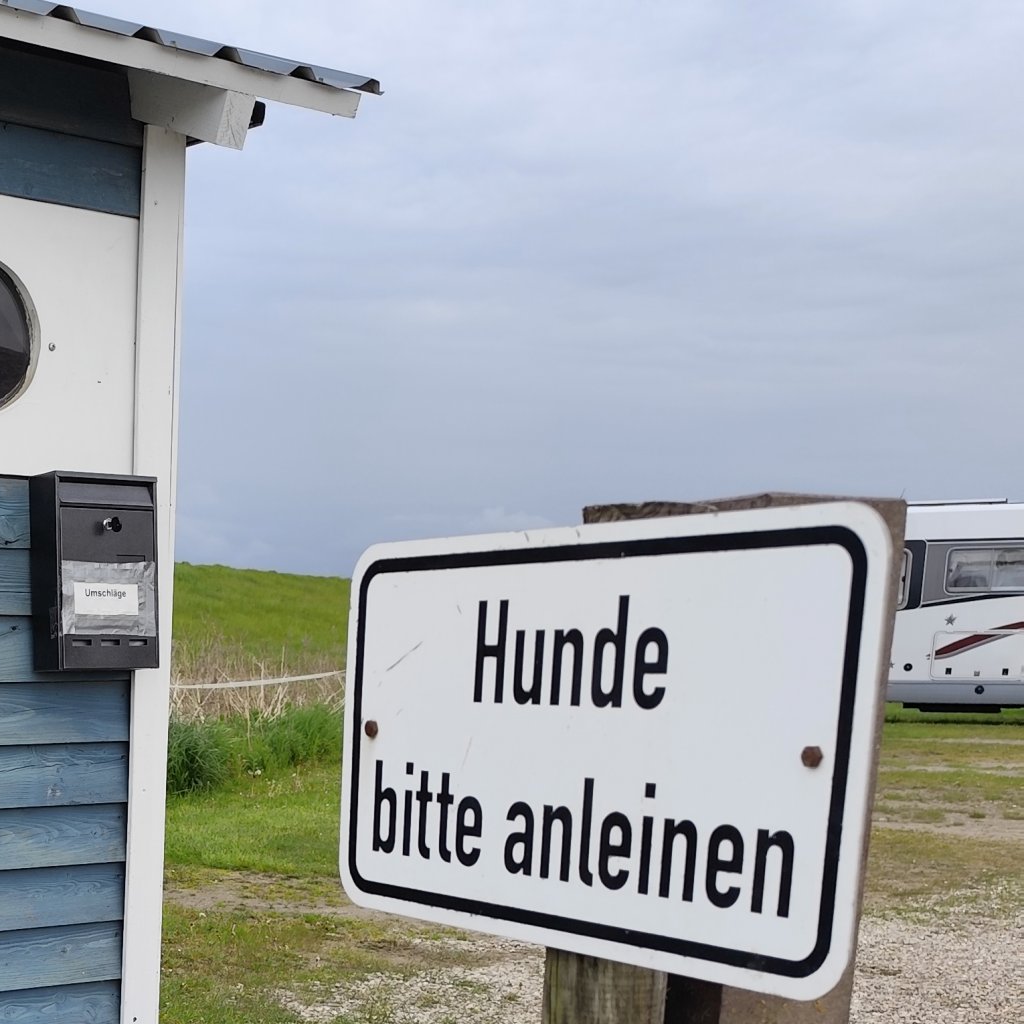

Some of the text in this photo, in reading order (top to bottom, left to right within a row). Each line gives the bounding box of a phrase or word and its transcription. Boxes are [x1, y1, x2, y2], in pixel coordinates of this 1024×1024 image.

[84, 588, 127, 600] Umschläge
[472, 594, 670, 710] Hunde
[372, 759, 795, 919] bitte anleinen
